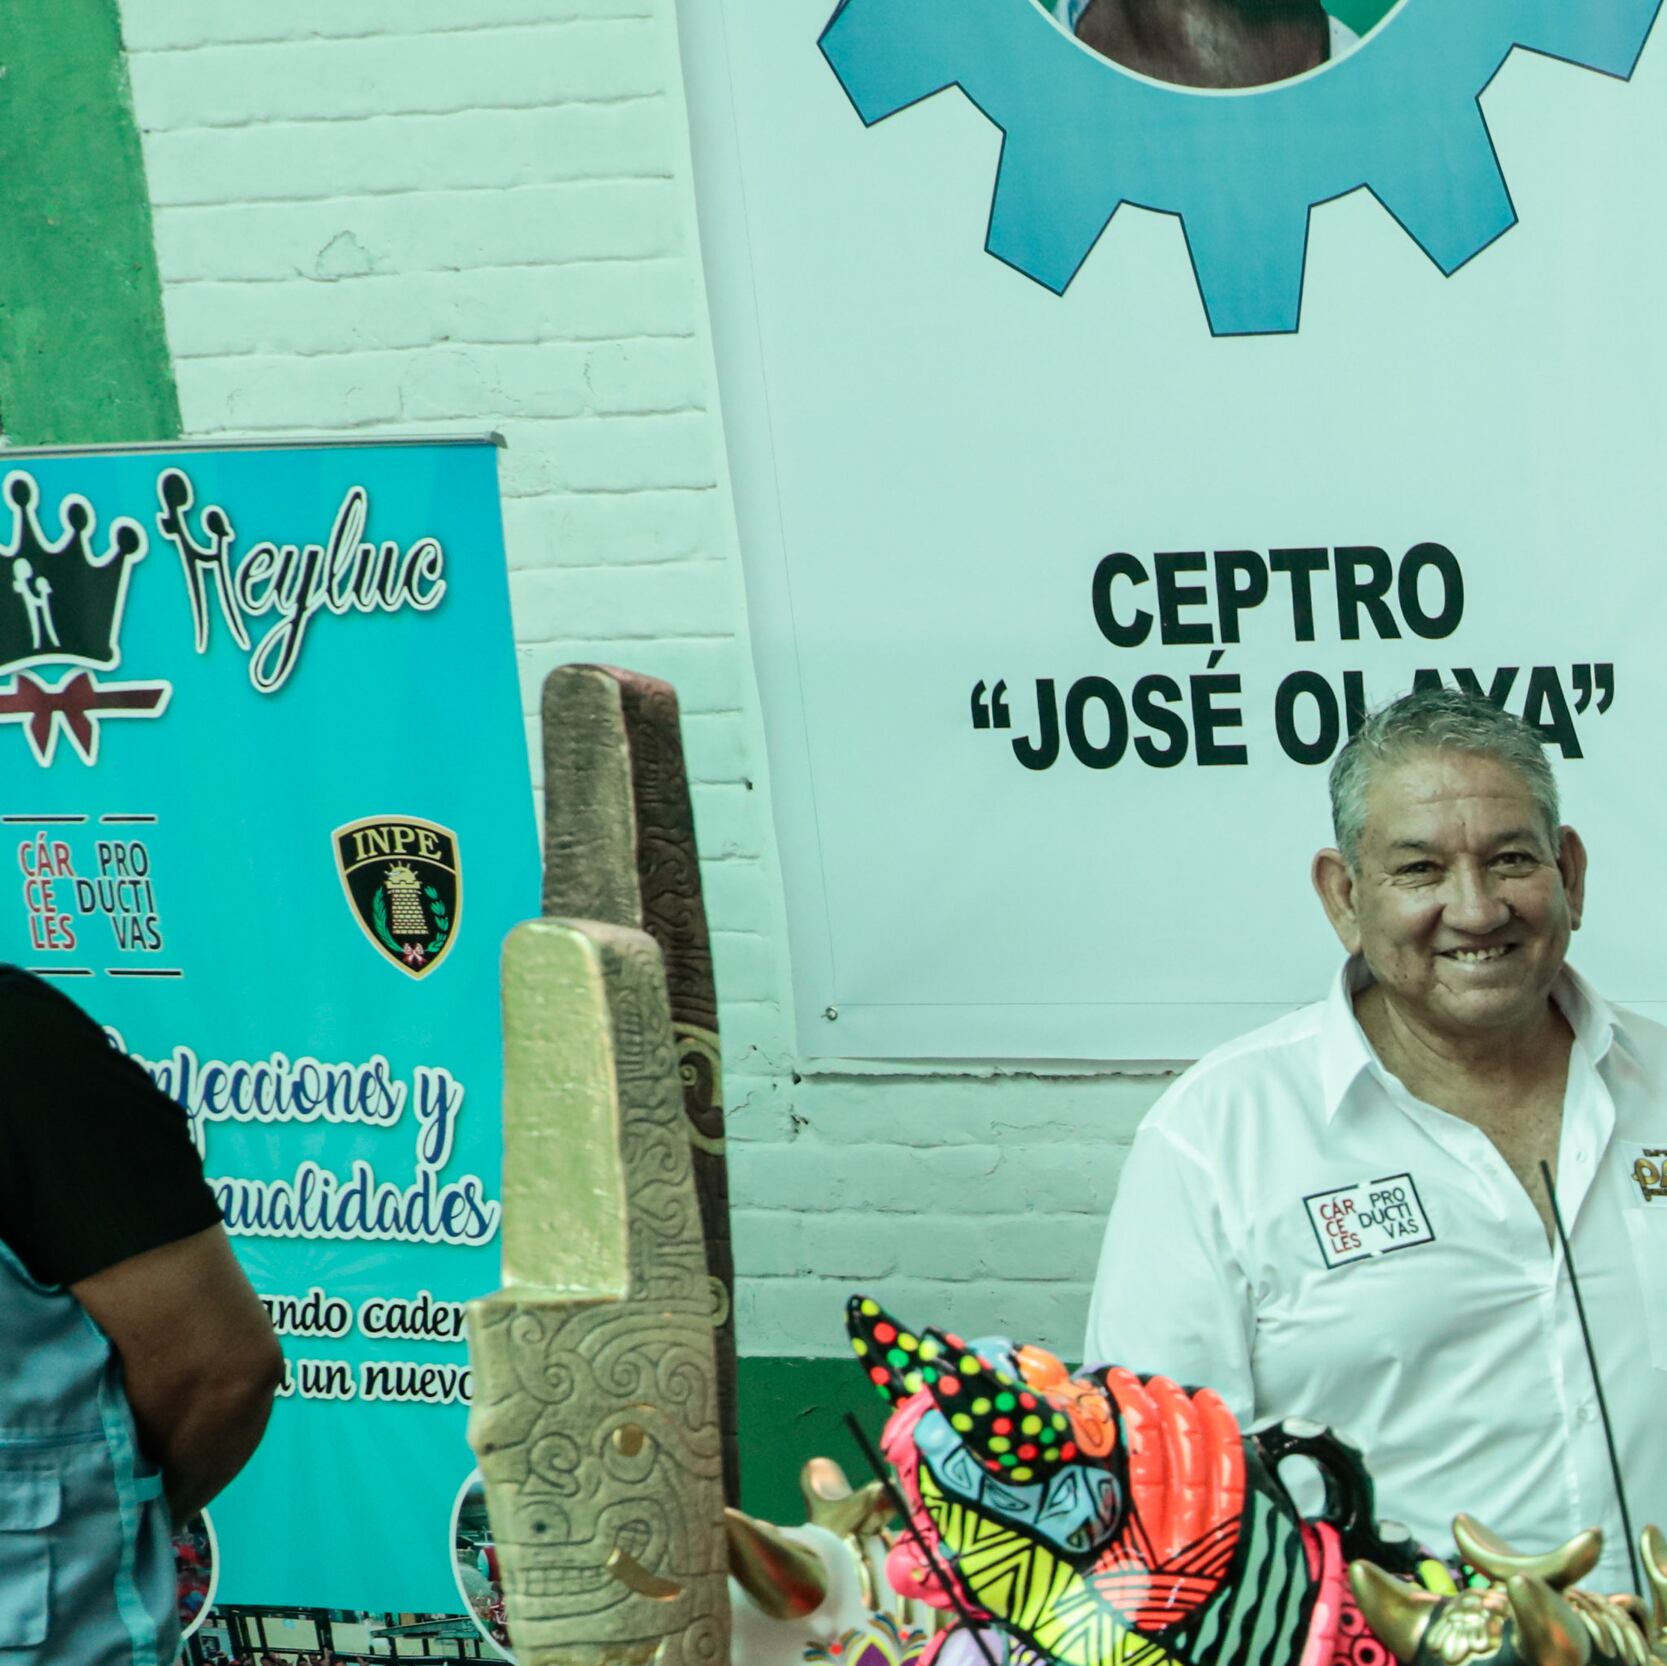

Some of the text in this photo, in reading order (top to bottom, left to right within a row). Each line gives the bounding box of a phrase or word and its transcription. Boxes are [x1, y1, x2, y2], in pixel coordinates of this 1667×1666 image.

[1091, 542, 1465, 648] CEPTRO
[20, 832, 149, 877] CÁR PRO
[353, 825, 443, 862] INPE
[26, 879, 154, 914] CE DUCTI
[31, 915, 162, 950] LES VAS
[420, 1071, 457, 1165] y
[1320, 1187, 1405, 1220] CÁR PRO
[1326, 1202, 1412, 1237] CE DUCTI
[1331, 1218, 1419, 1254] LES VAS
[302, 1363, 351, 1395] un
